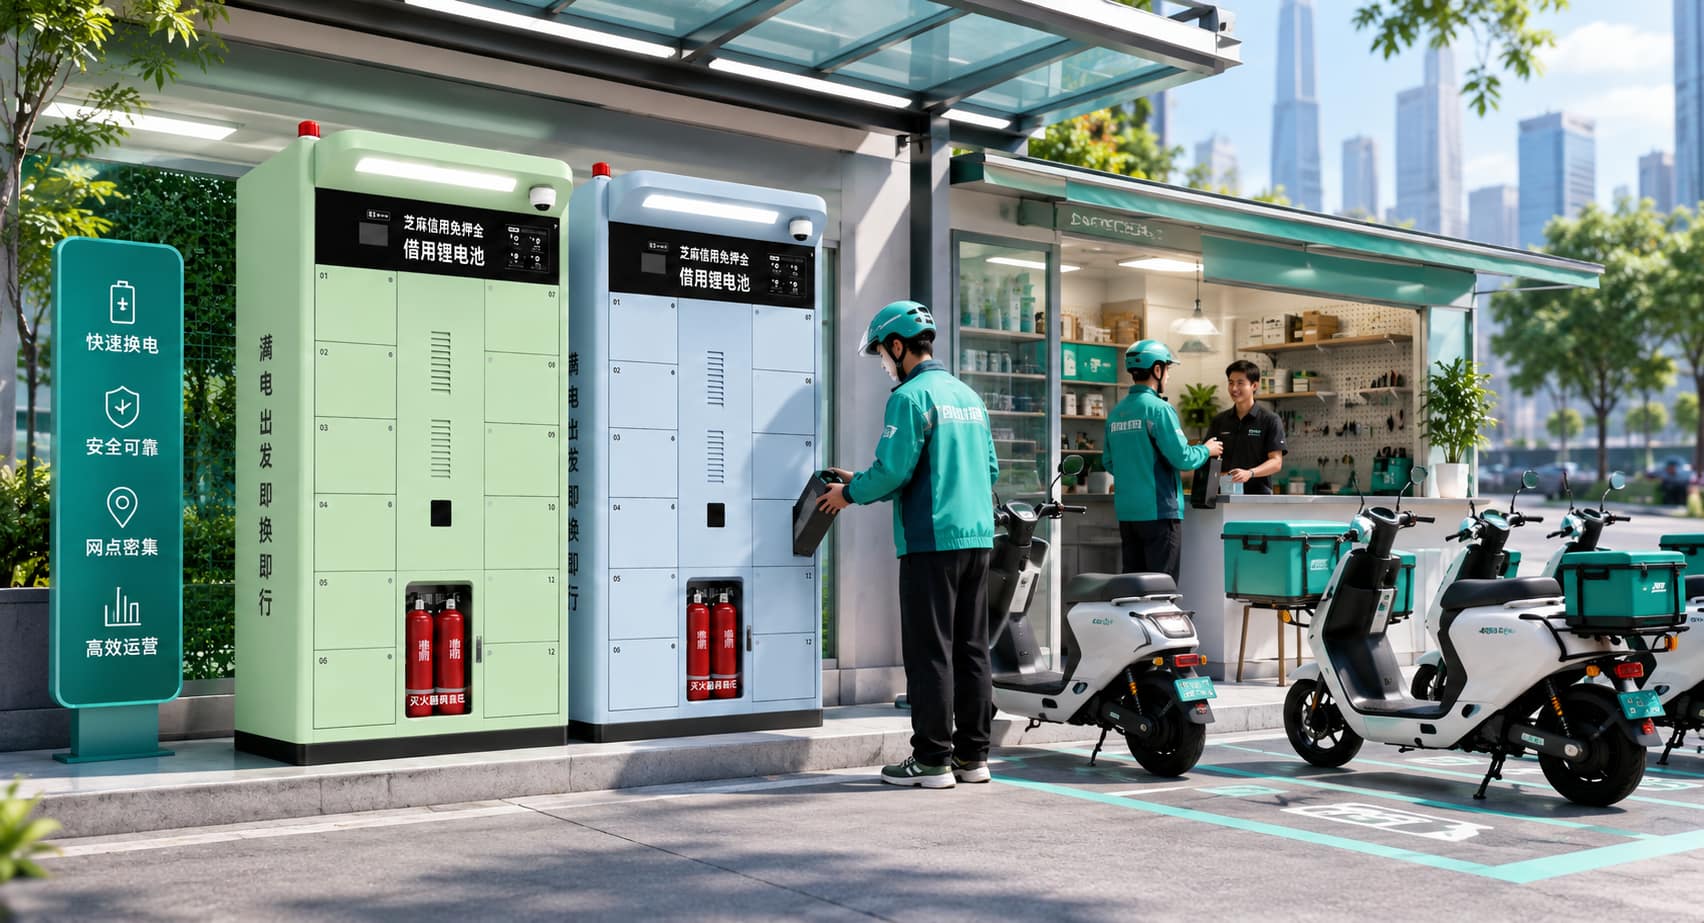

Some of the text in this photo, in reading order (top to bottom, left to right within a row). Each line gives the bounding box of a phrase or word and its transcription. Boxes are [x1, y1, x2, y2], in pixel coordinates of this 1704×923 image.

[403, 238, 485, 266] 借用锂电池
[680, 266, 750, 292] 借用锂电池
[86, 332, 159, 354] 快速换电
[86, 437, 158, 458] 安全可靠
[259, 334, 273, 616] 满电出发即换即行
[86, 538, 158, 557] 网点密集
[86, 637, 158, 657] 高效运营
